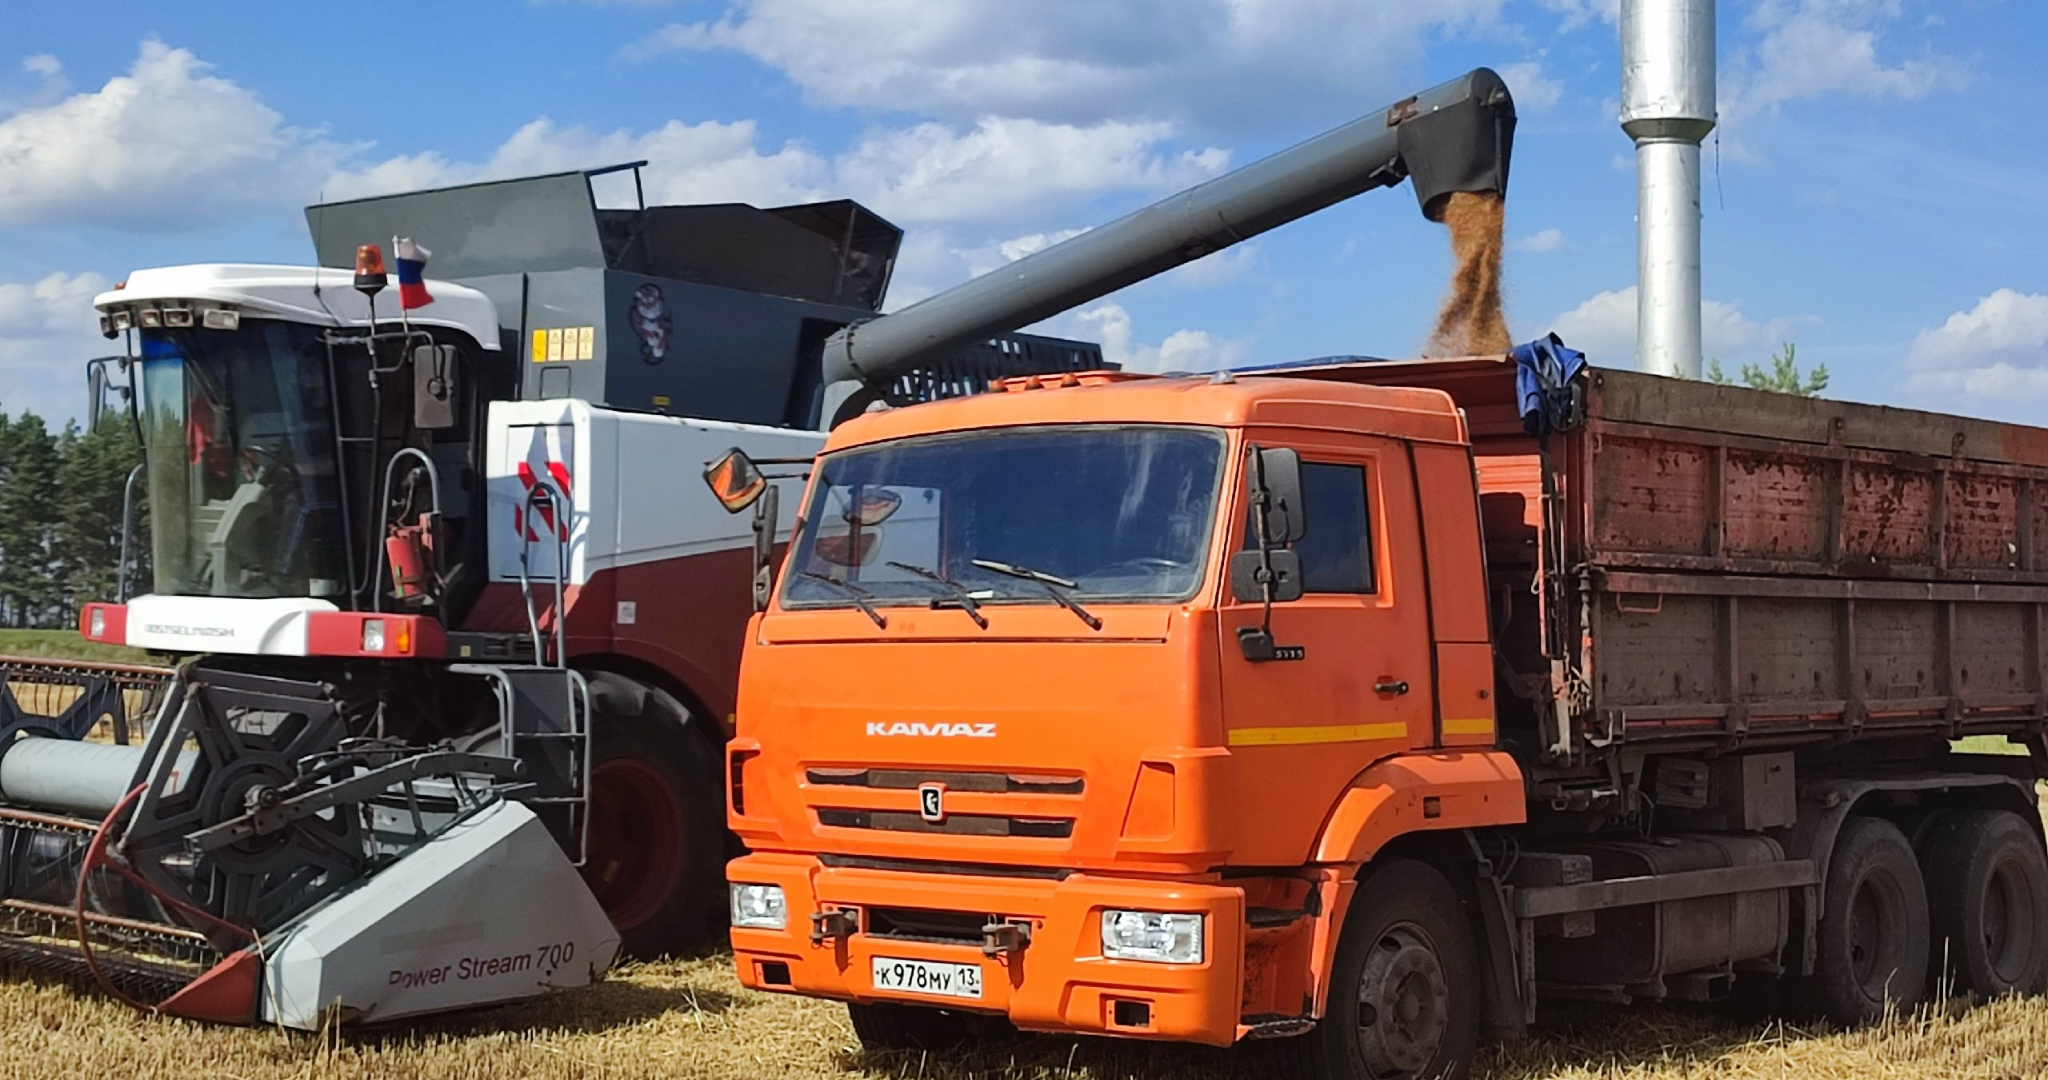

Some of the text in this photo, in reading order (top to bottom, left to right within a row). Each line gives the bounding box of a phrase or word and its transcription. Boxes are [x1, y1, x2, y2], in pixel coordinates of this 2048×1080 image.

[1275, 649, 1303, 659] 5115
[866, 722, 997, 737] KAMAZ
[388, 942, 575, 989] Power Stream 700
[957, 968, 975, 986] 13
